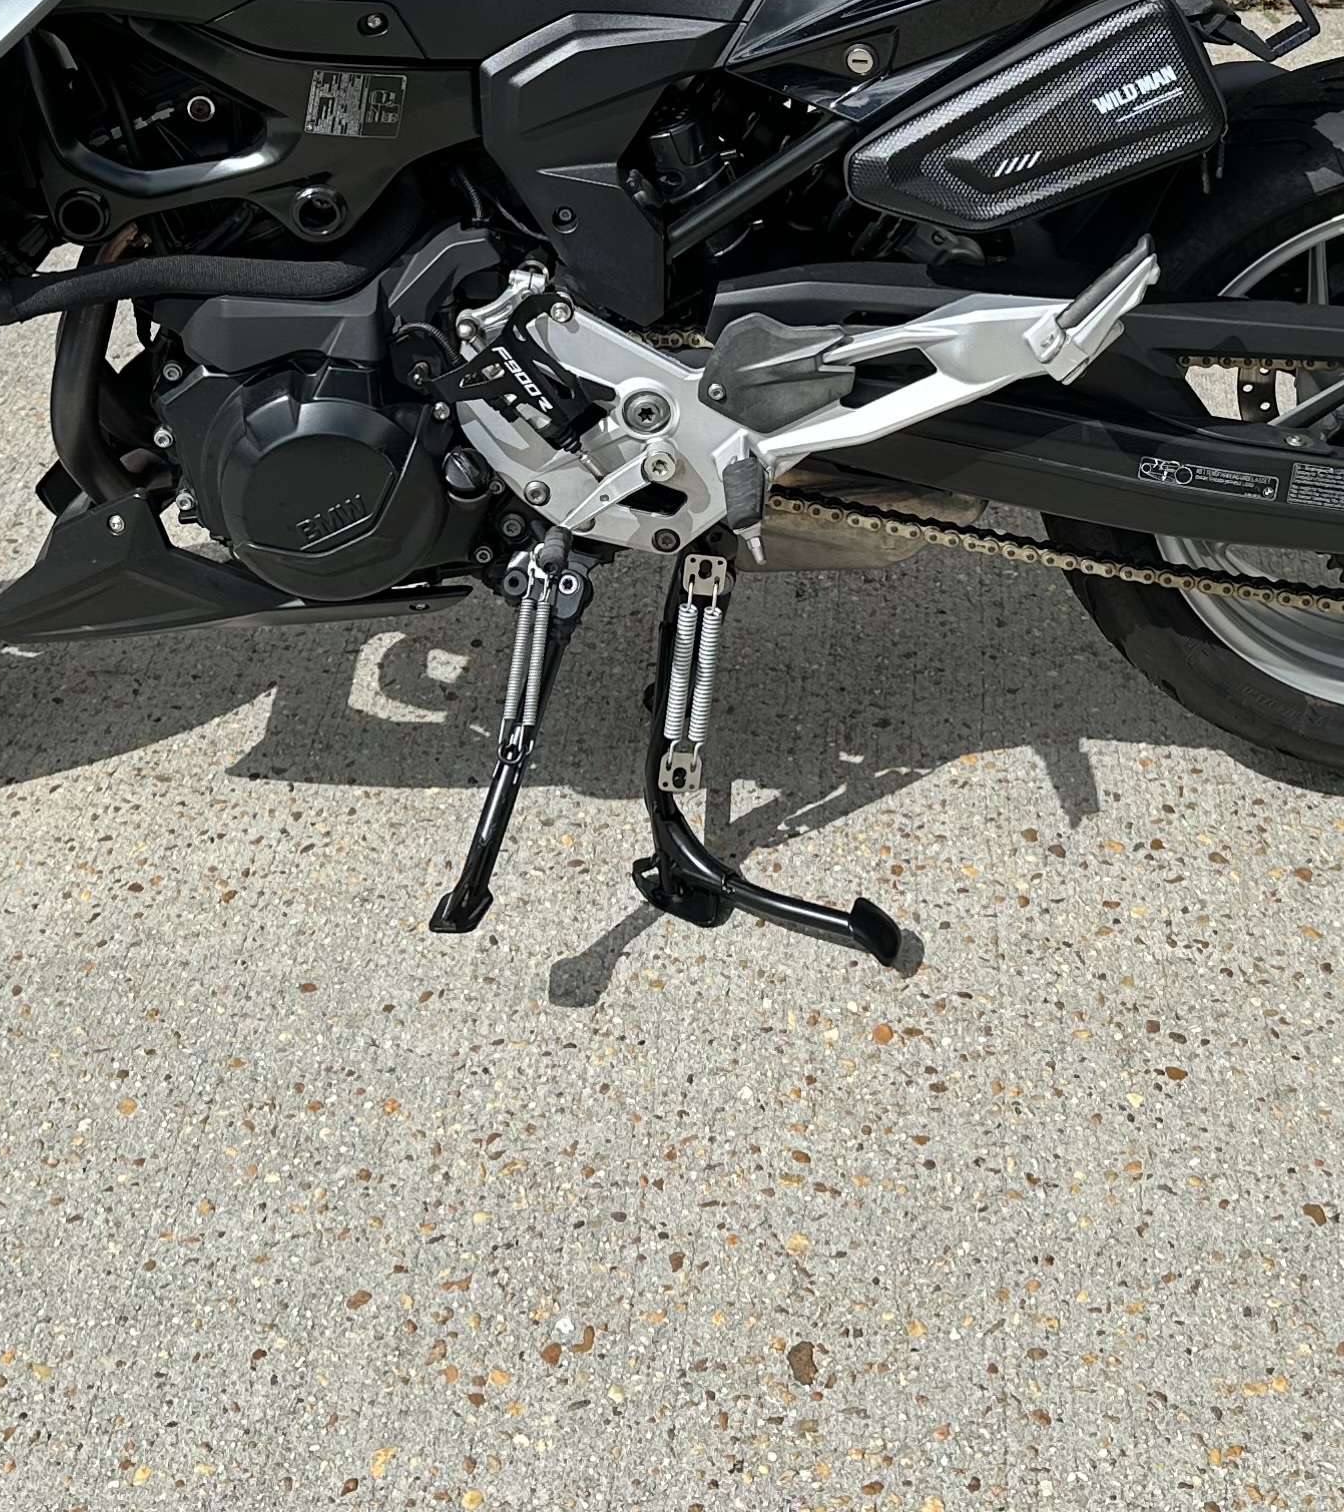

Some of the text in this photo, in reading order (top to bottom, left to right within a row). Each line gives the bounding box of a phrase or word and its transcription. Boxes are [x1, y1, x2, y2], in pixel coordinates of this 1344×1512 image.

[1092, 65, 1177, 114] WILD MAN
[492, 347, 542, 397] F900
[296, 494, 367, 539] BMW
